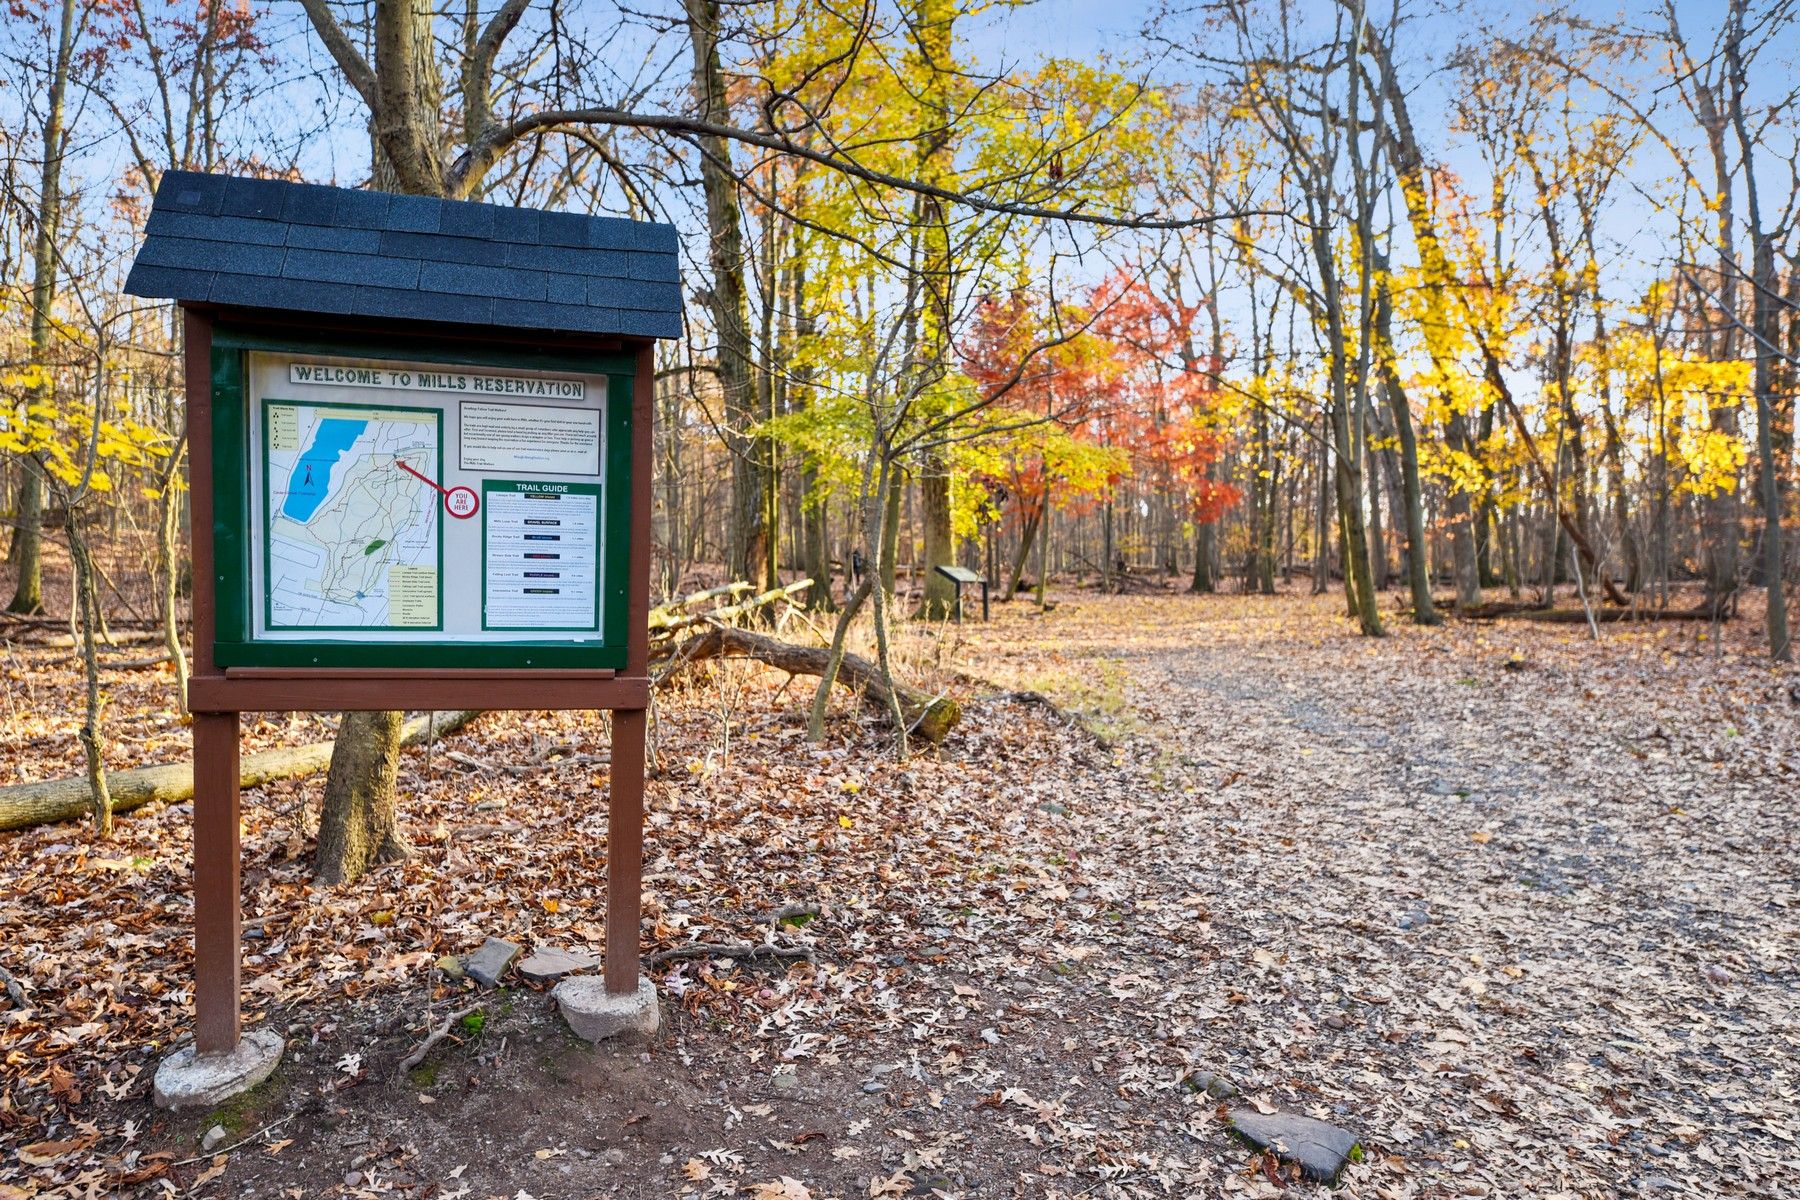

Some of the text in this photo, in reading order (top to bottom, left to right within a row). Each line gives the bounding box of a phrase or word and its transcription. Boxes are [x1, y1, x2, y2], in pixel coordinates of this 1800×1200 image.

[295, 366, 582, 397] WELCOME TO MILLS RESERVATION
[516, 483, 568, 493] TRAIL GUIDE
